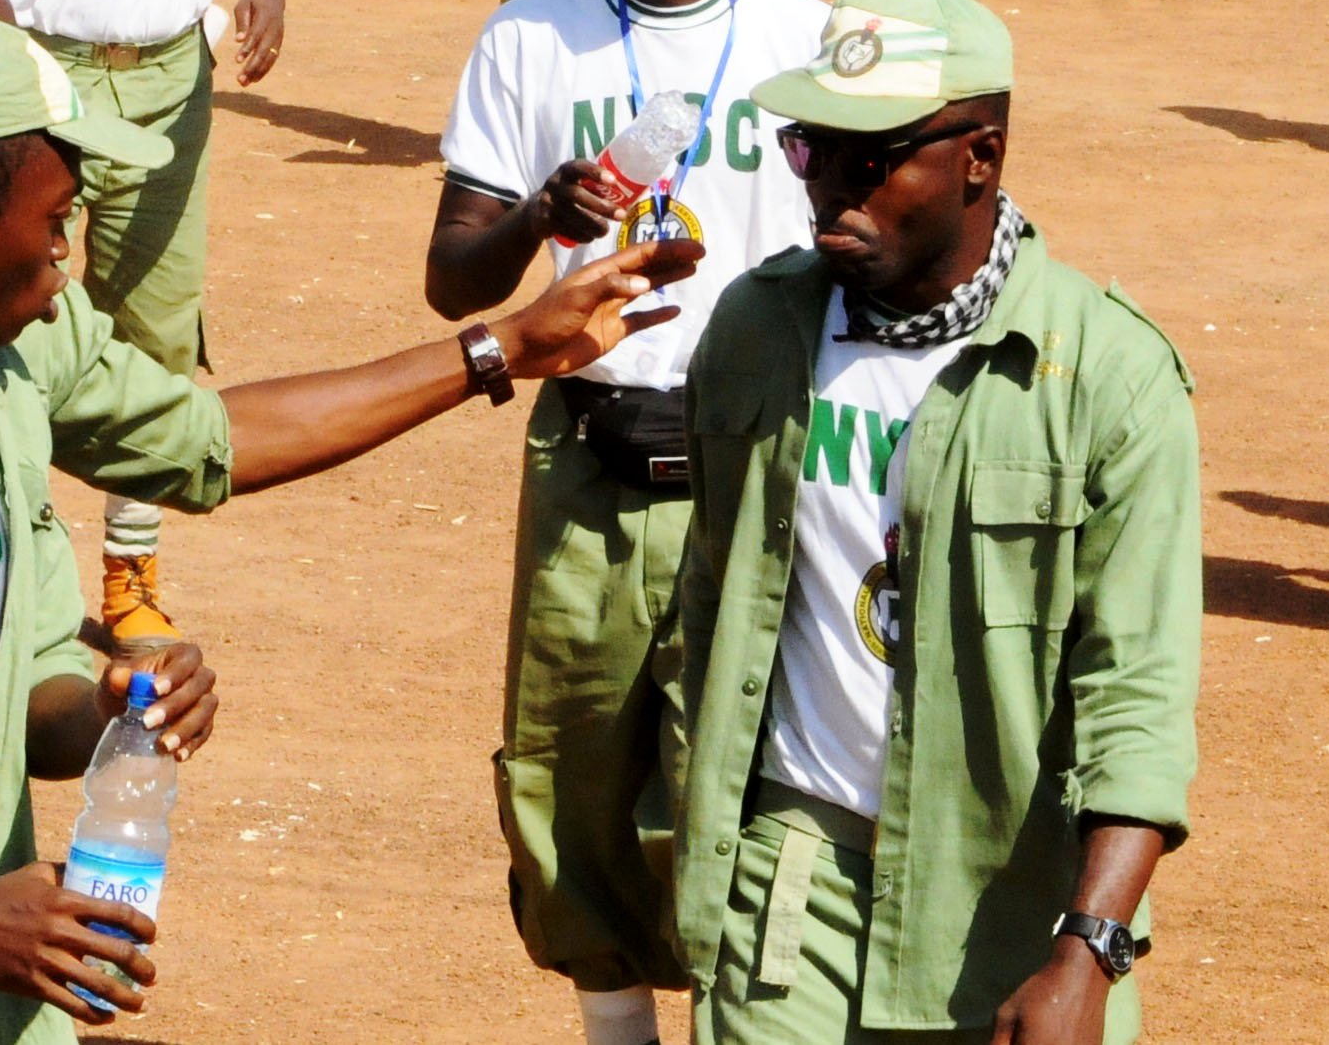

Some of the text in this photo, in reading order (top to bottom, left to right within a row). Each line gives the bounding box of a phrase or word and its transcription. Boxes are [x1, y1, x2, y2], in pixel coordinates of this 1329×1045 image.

[573, 99, 763, 172] NSC
[802, 397, 909, 497] NY
[91, 879, 148, 904] FARO
